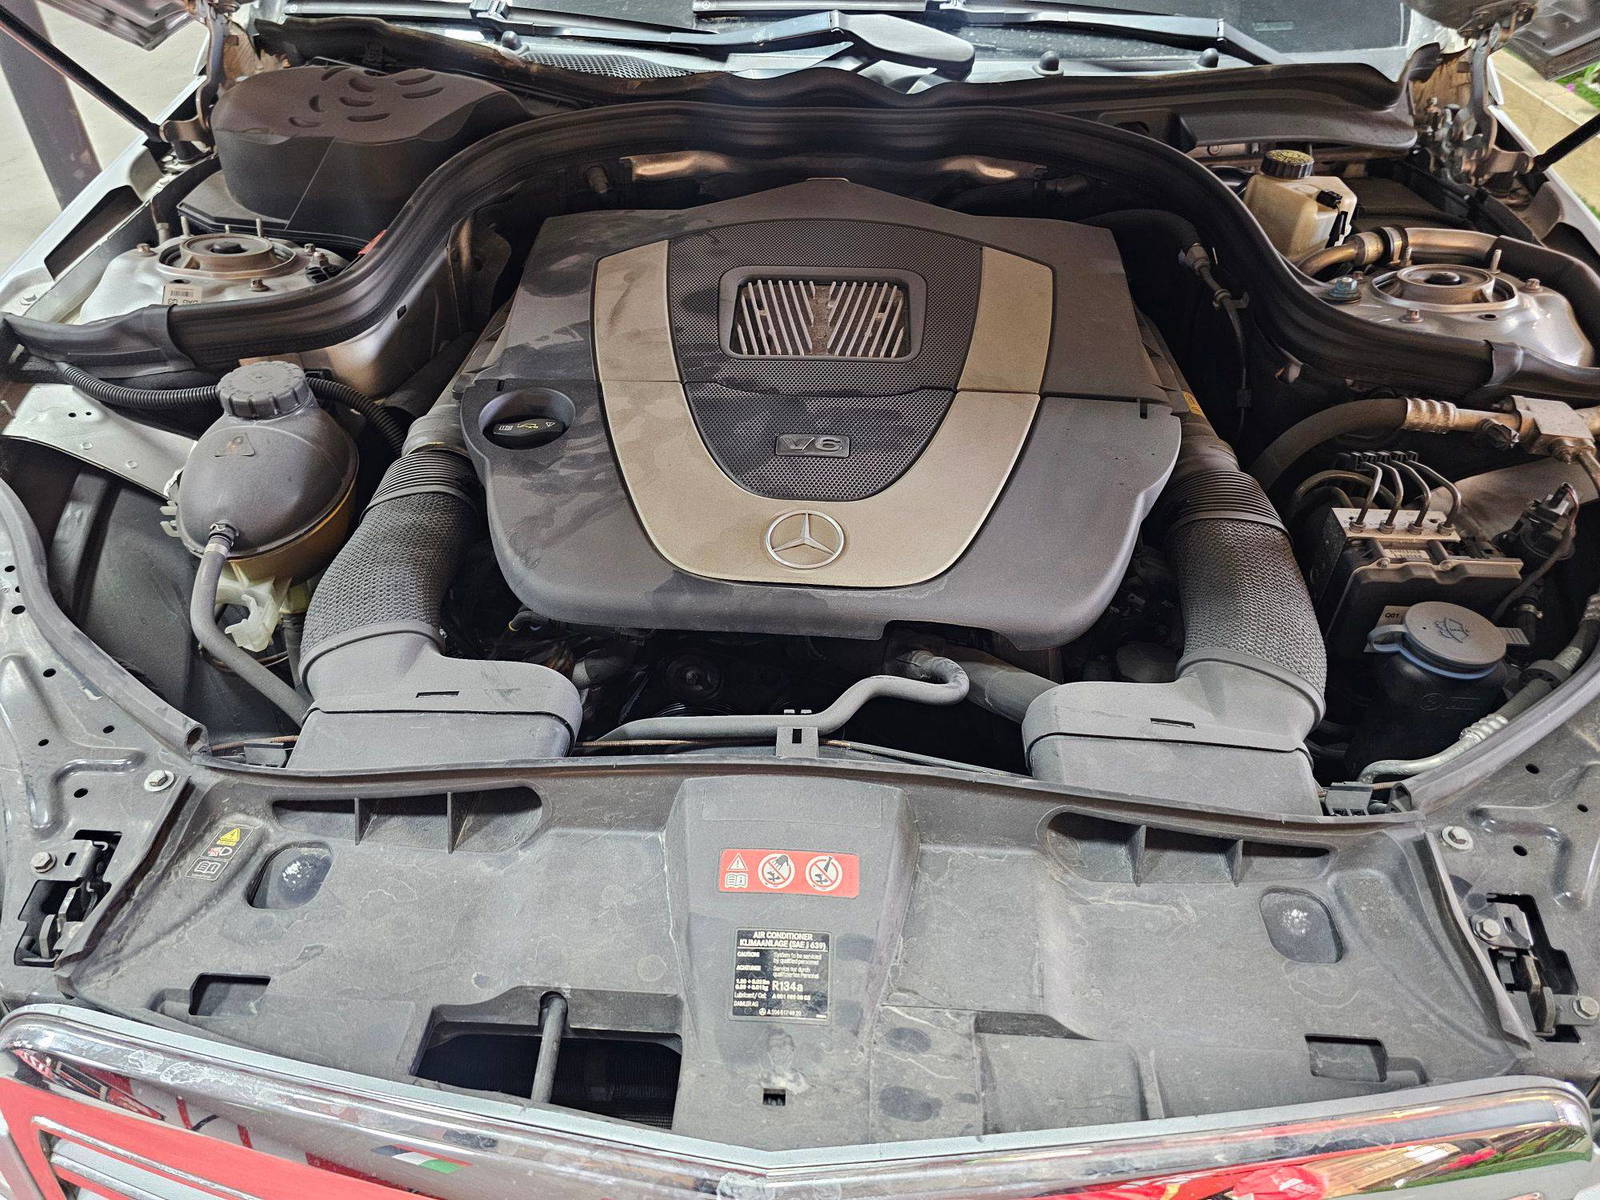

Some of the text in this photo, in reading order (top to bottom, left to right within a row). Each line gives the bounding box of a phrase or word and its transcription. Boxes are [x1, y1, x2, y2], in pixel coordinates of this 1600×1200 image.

[780, 437, 842, 452] V6
[753, 931, 813, 940] AIR CONDITIONER
[740, 938, 789, 948] KLIMAANLAGE
[789, 940, 805, 949] (SAE
[810, 942, 826, 951] 639)
[772, 980, 803, 992] R134a
